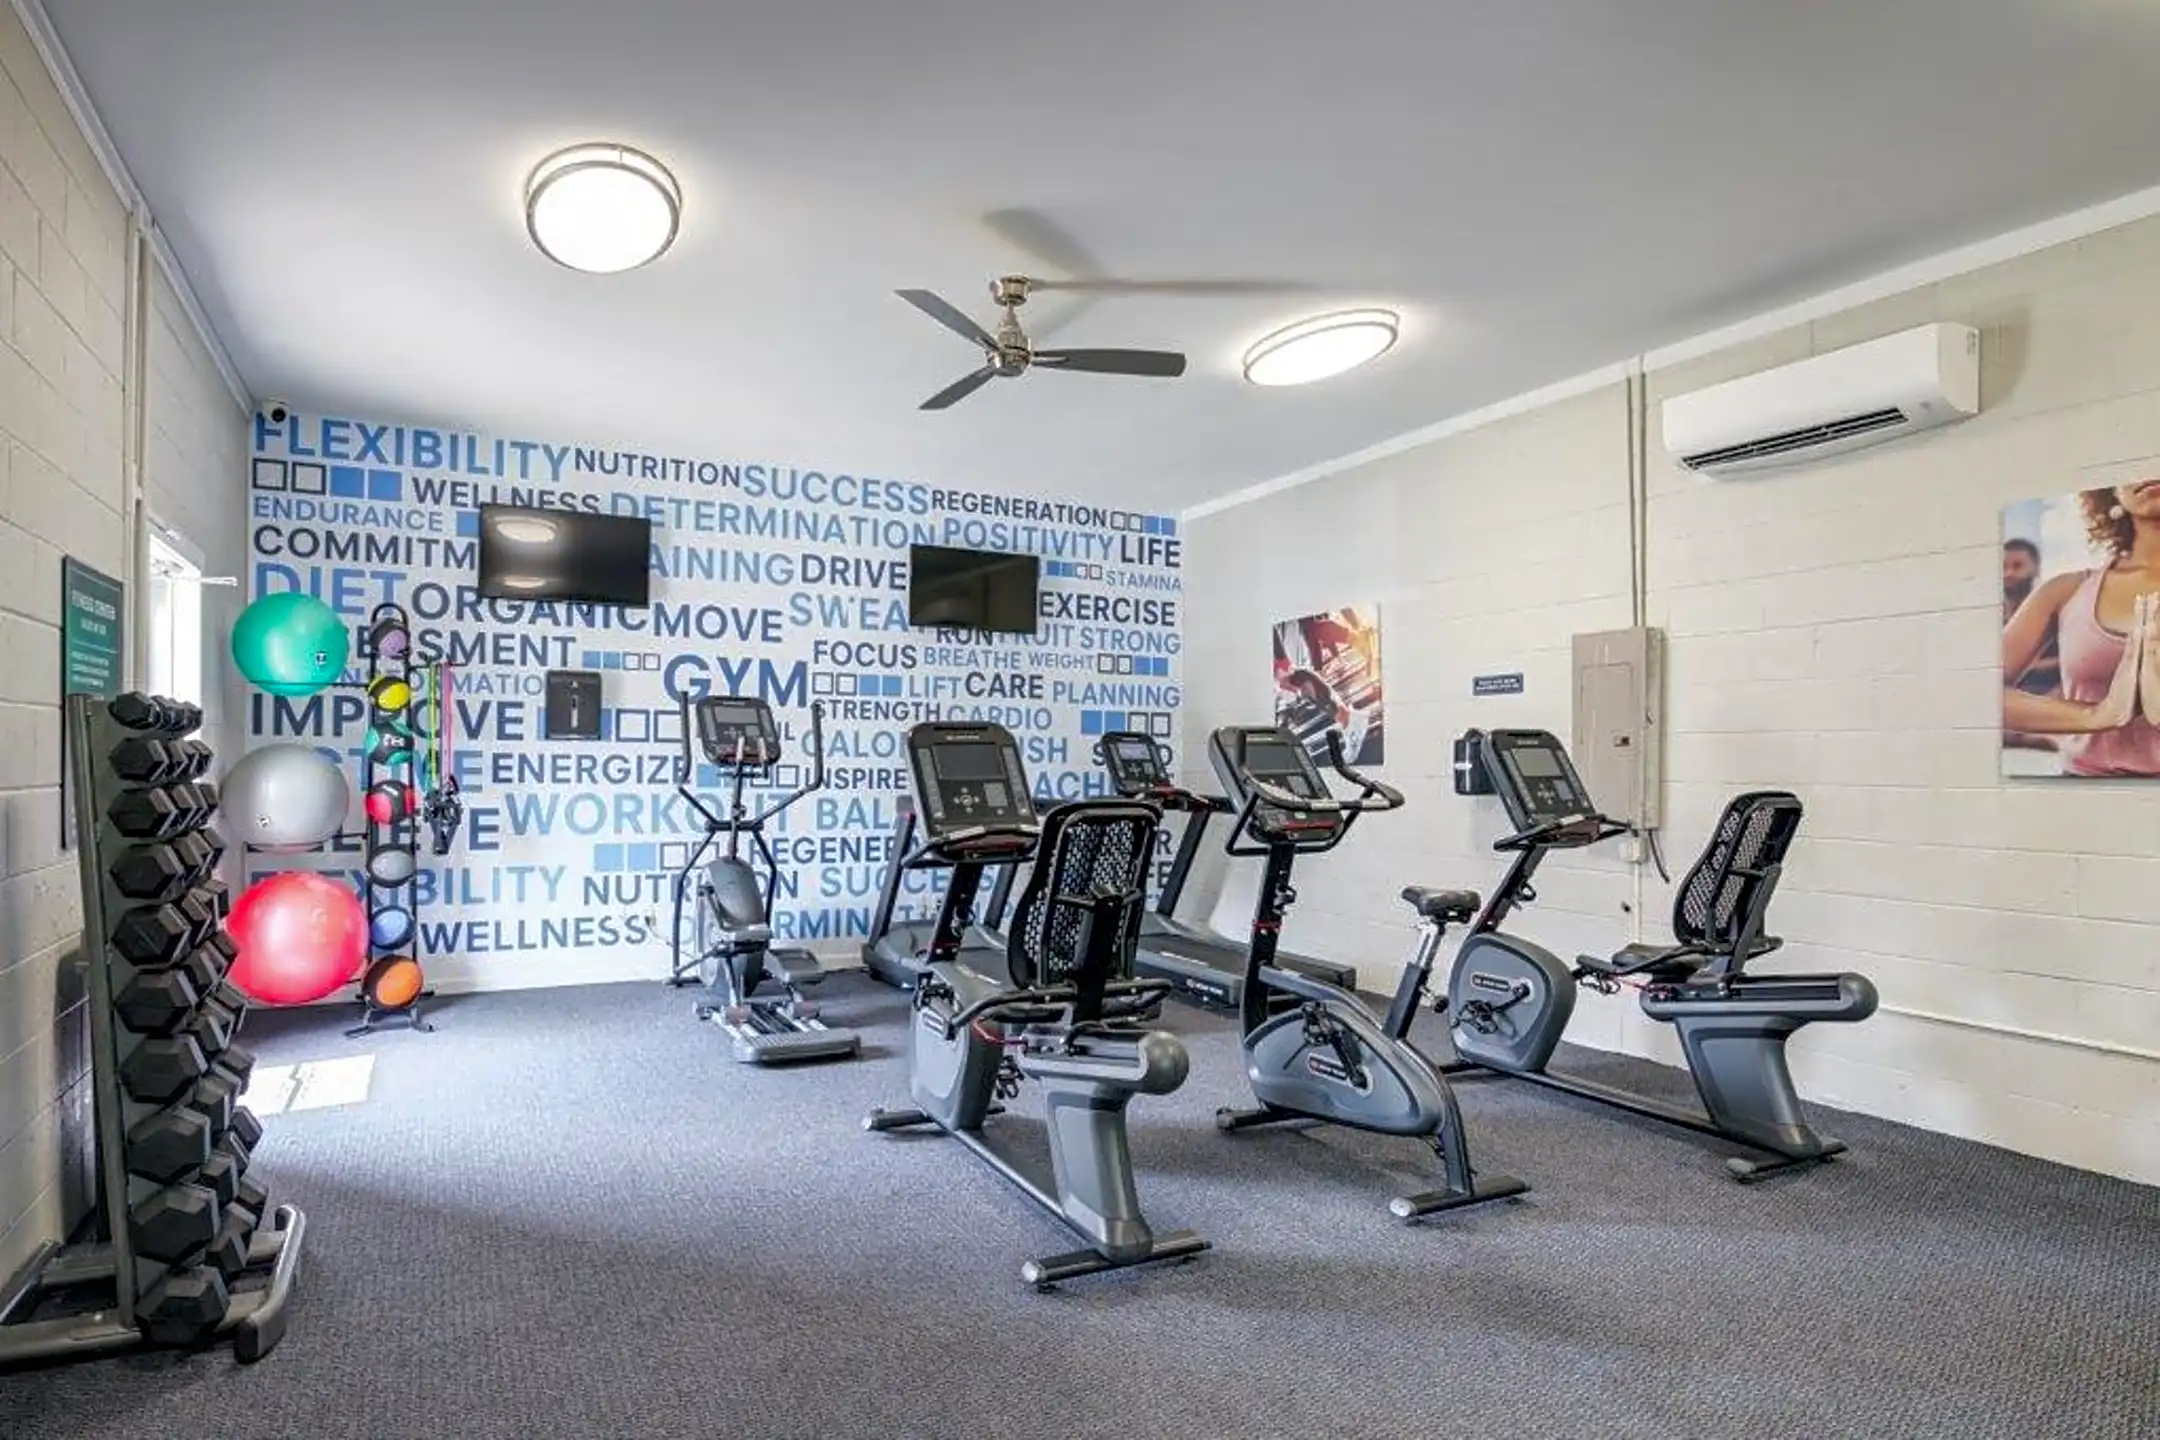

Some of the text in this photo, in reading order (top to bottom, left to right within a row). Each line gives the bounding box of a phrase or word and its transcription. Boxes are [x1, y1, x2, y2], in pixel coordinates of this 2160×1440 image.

[255, 411, 1108, 528] FLEXIBILITY NUTRITION SUCCESS REGENERATION
[254, 496, 443, 532] ENDURANCE
[611, 492, 935, 549] DETERMINATION
[944, 518, 1114, 560] POSITIVITY
[1121, 535, 1181, 567] LIFE
[801, 553, 906, 590] DRIVE
[1106, 570, 1181, 594] STAMINA
[412, 582, 646, 631] ORGANIC
[654, 602, 782, 643] MOVE
[789, 592, 925, 633] SWEA
[1040, 591, 1176, 627] EXERCISE
[814, 640, 1096, 670] FOCUS BREATHE WEIGHT
[1080, 627, 1181, 655] STRONG
[664, 654, 808, 709] GYM
[909, 674, 962, 700] LIFT
[965, 671, 1044, 699] CARE
[1053, 680, 1181, 709] PLANNING
[252, 692, 524, 741] IMPOVE
[947, 704, 1053, 731] CARDIO
[816, 796, 899, 832] BAL
[421, 914, 648, 954] WELLNESS
